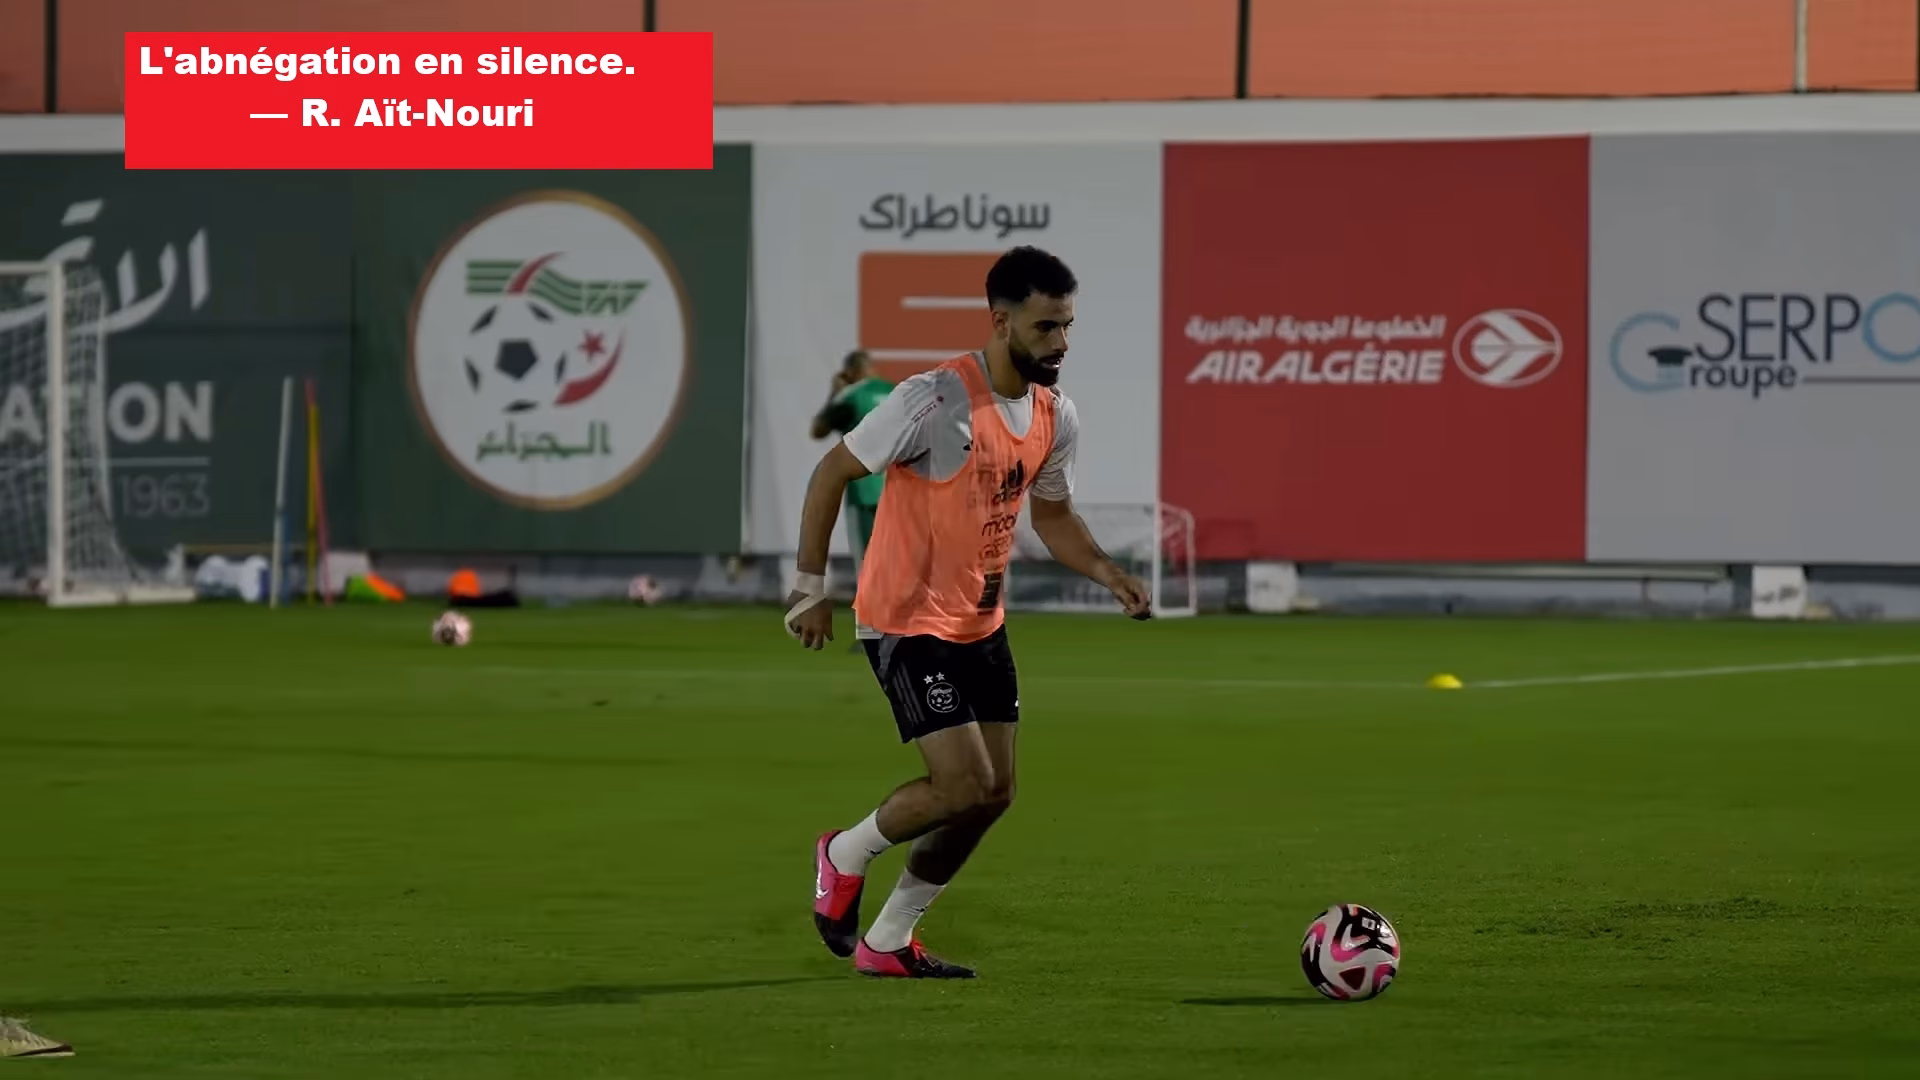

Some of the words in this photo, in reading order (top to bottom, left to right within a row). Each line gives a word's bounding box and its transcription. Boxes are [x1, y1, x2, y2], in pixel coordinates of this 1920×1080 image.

[1185, 350, 1264, 384] AIR
[1262, 342, 1447, 384] ALGÉRIE
[120, 473, 211, 519] 1963
